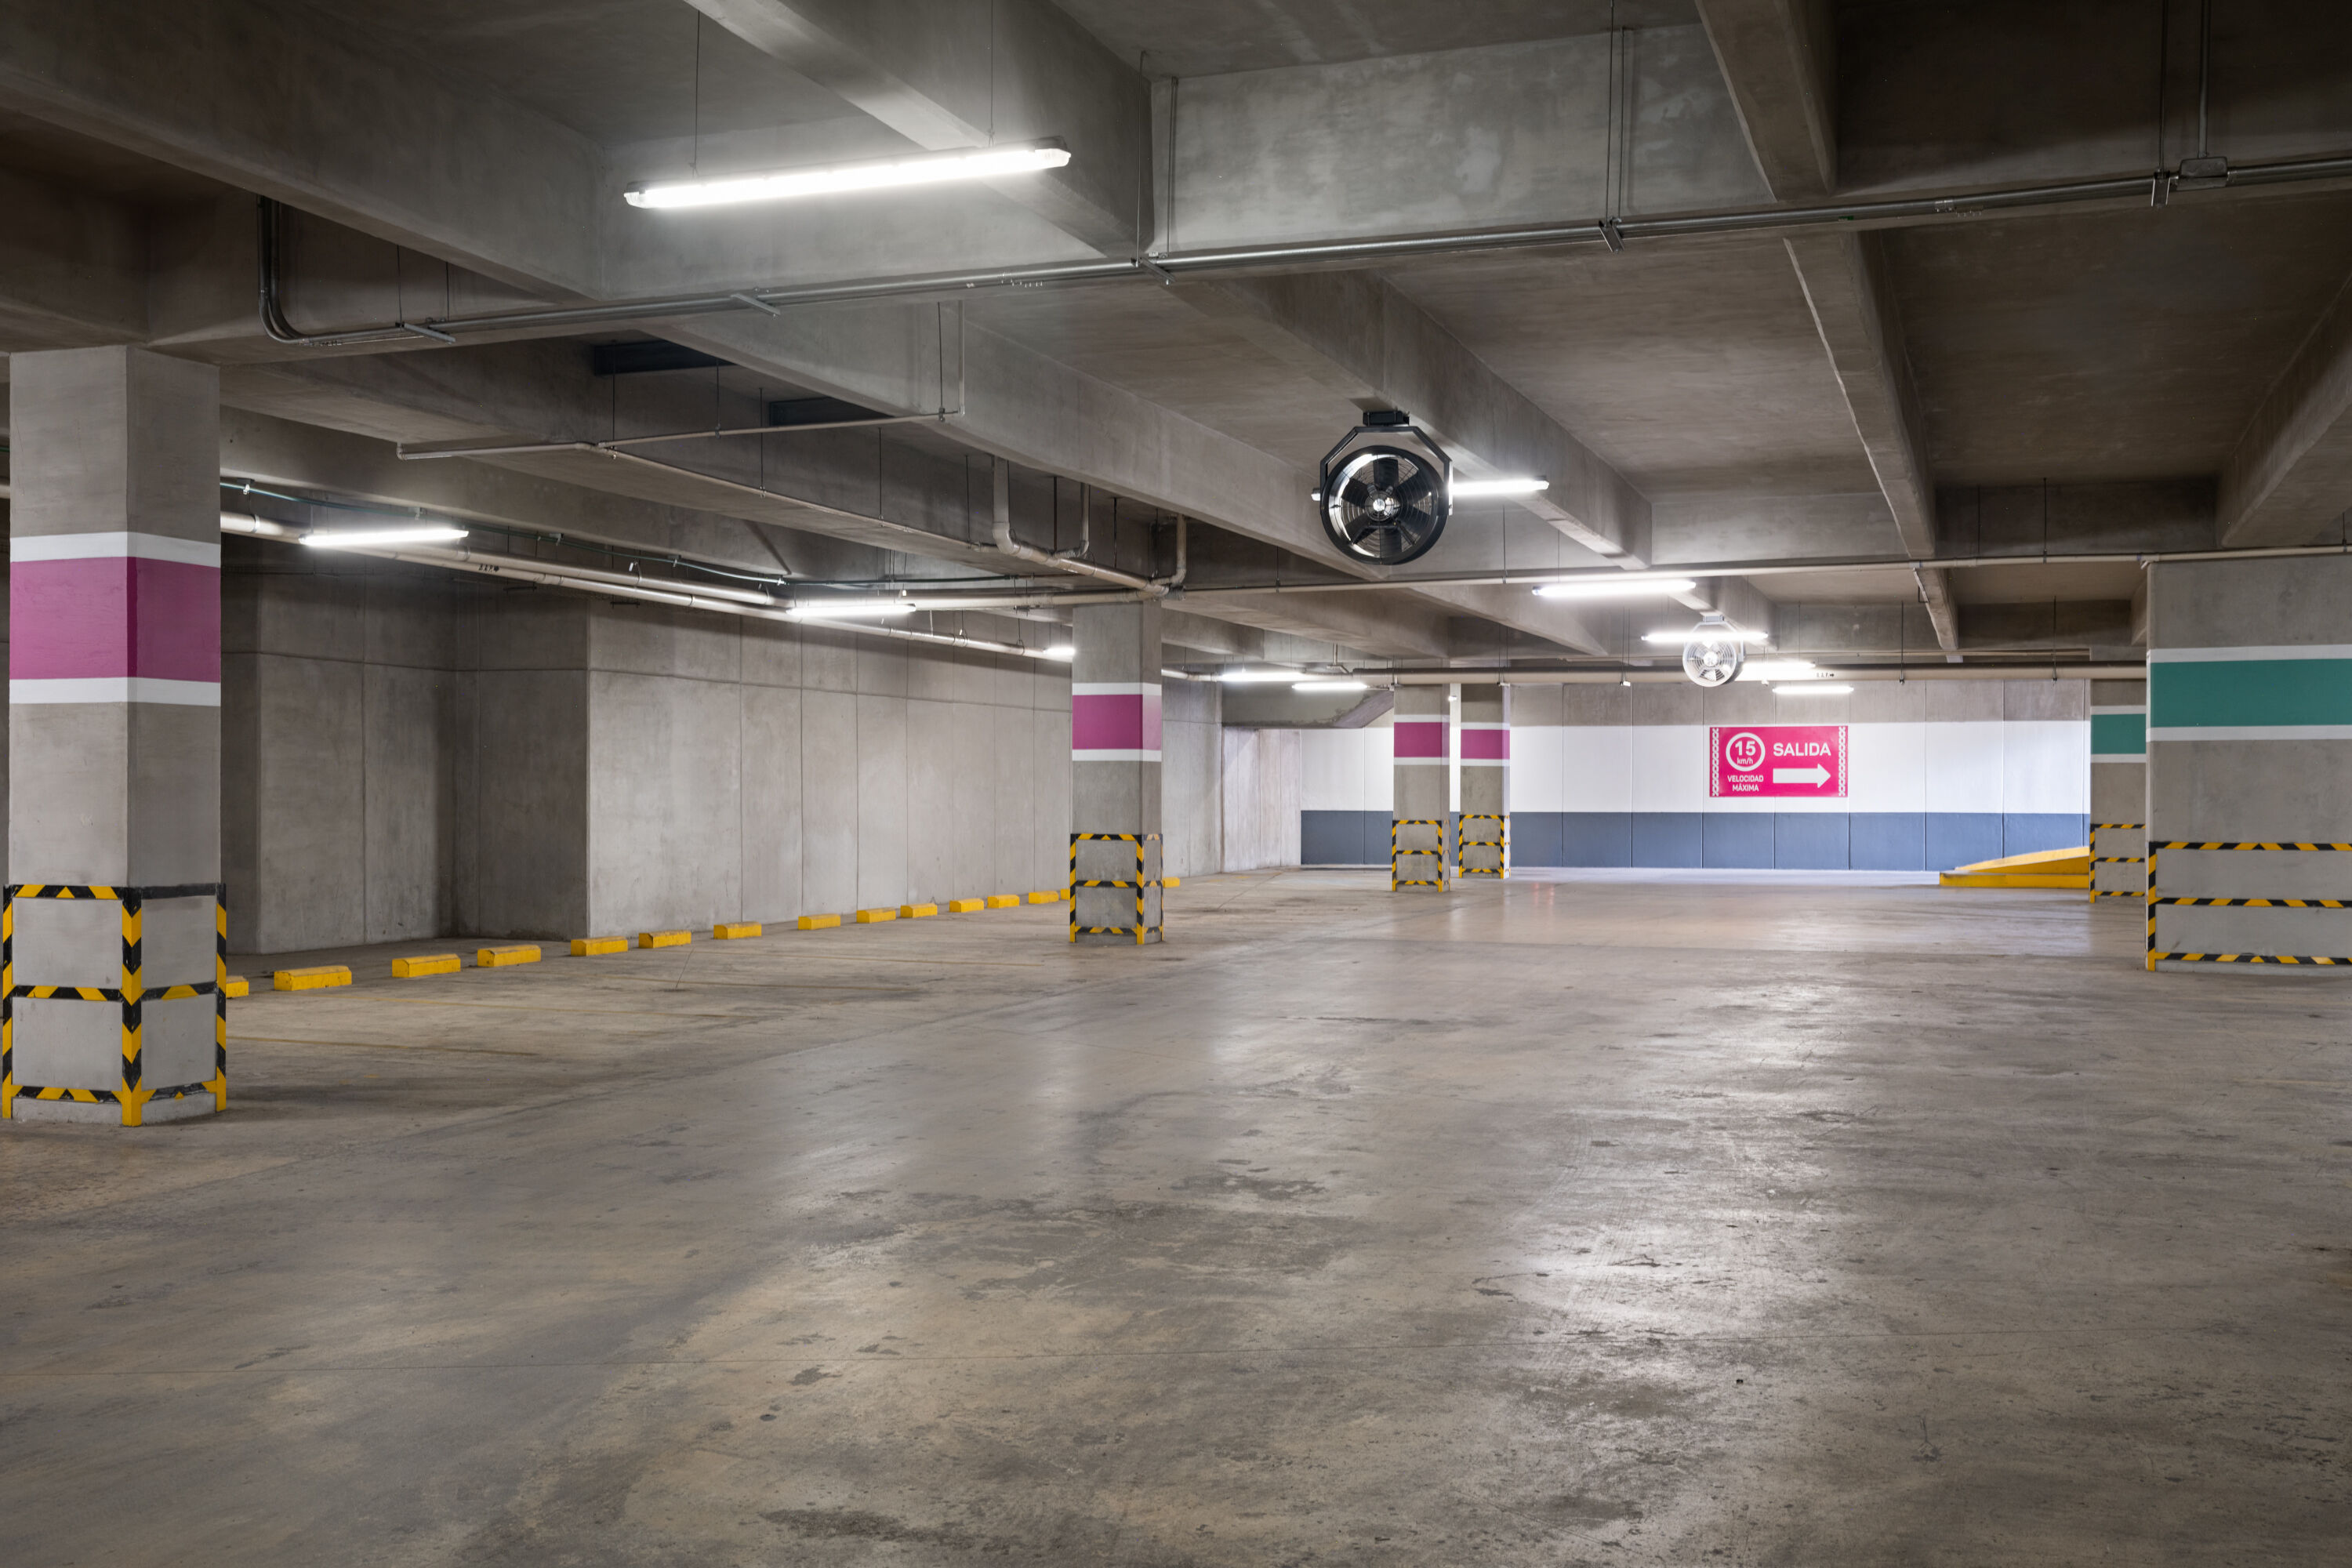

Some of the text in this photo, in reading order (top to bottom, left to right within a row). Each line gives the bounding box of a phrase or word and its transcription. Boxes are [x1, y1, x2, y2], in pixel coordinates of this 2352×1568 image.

[1735, 741, 1756, 756] 15
[1773, 742, 1831, 757] SALIDA
[1732, 782, 1759, 792] MÁXIMA
